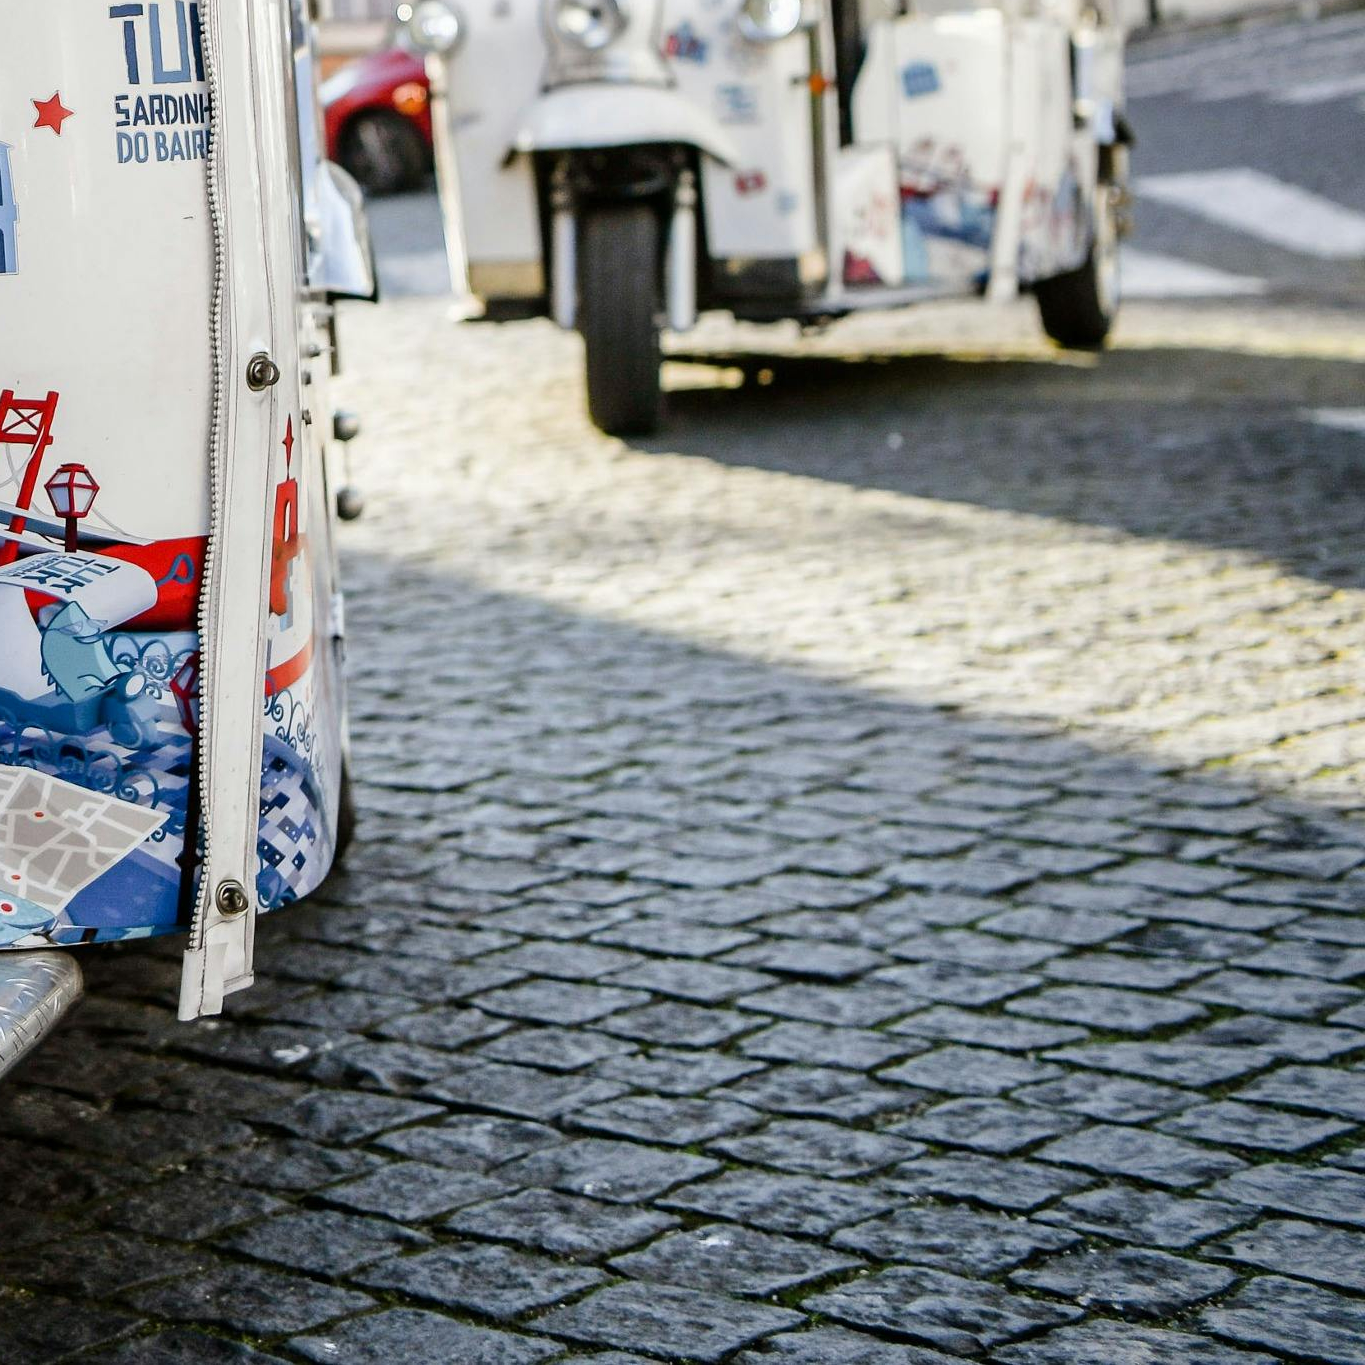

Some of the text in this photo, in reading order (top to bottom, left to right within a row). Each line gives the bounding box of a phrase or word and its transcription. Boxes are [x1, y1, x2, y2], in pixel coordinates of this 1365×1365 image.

[115, 93, 213, 126] SARDINH
[117, 130, 212, 163] DO BAIR
